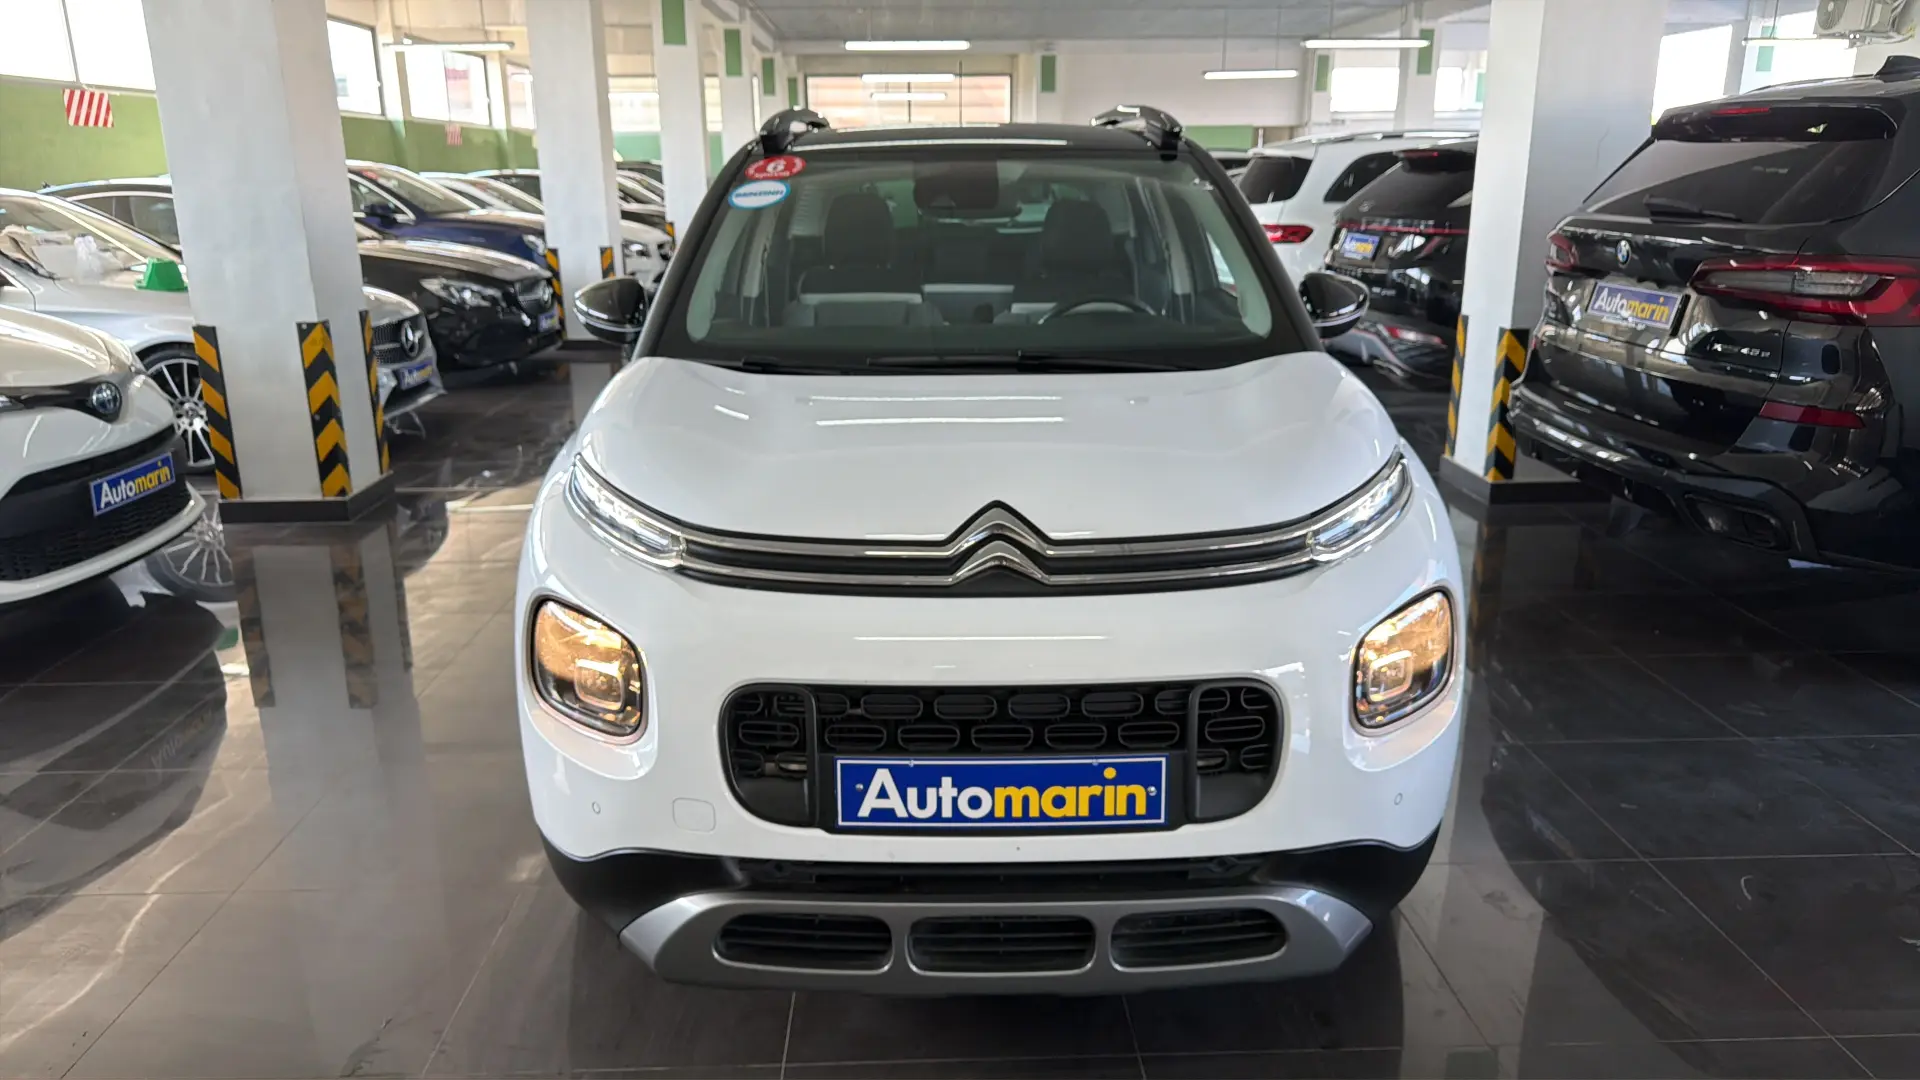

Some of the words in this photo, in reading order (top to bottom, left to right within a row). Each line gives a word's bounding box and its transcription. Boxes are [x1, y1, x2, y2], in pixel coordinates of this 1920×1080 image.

[1594, 287, 1669, 323] Automarin
[100, 460, 171, 508] Automarin
[857, 767, 1147, 819] Automarin
